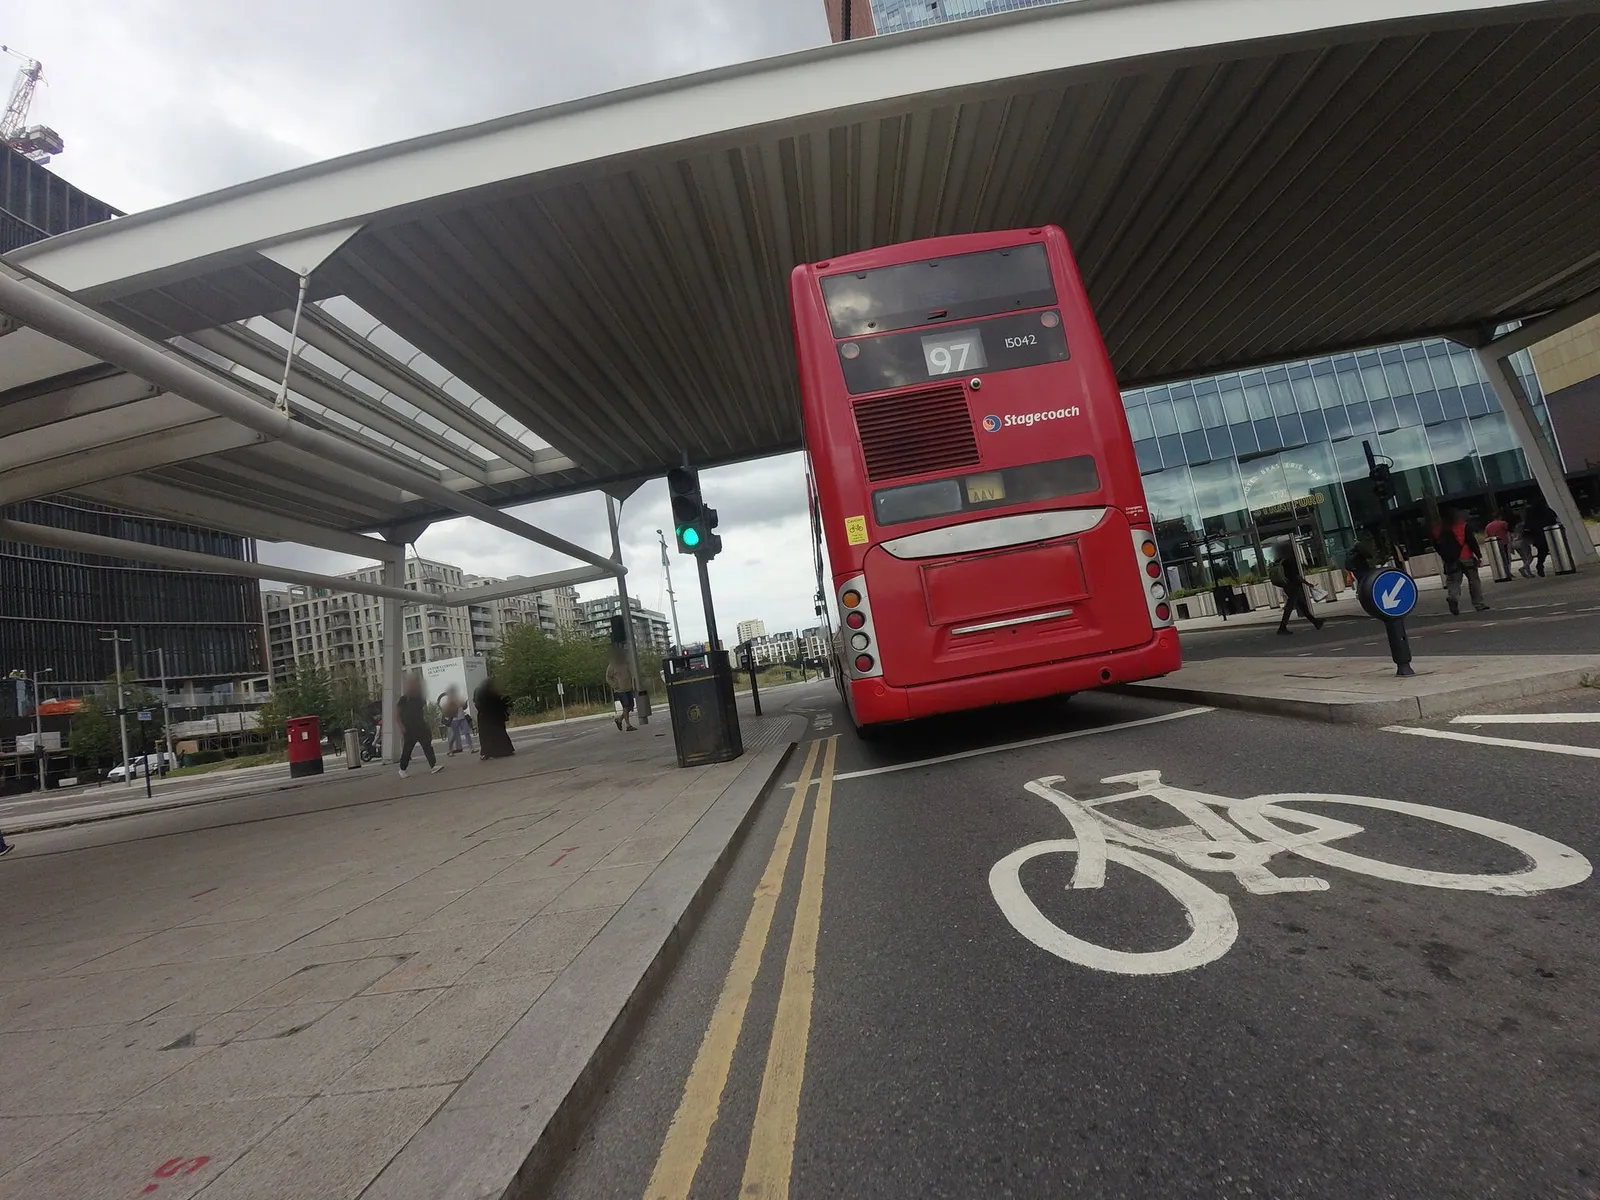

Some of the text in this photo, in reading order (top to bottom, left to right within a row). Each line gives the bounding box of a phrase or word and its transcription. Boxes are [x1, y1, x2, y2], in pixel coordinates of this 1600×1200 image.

[1004, 334, 1038, 349] 15042
[929, 343, 972, 375] 97
[1004, 405, 1080, 427] Stagecoach
